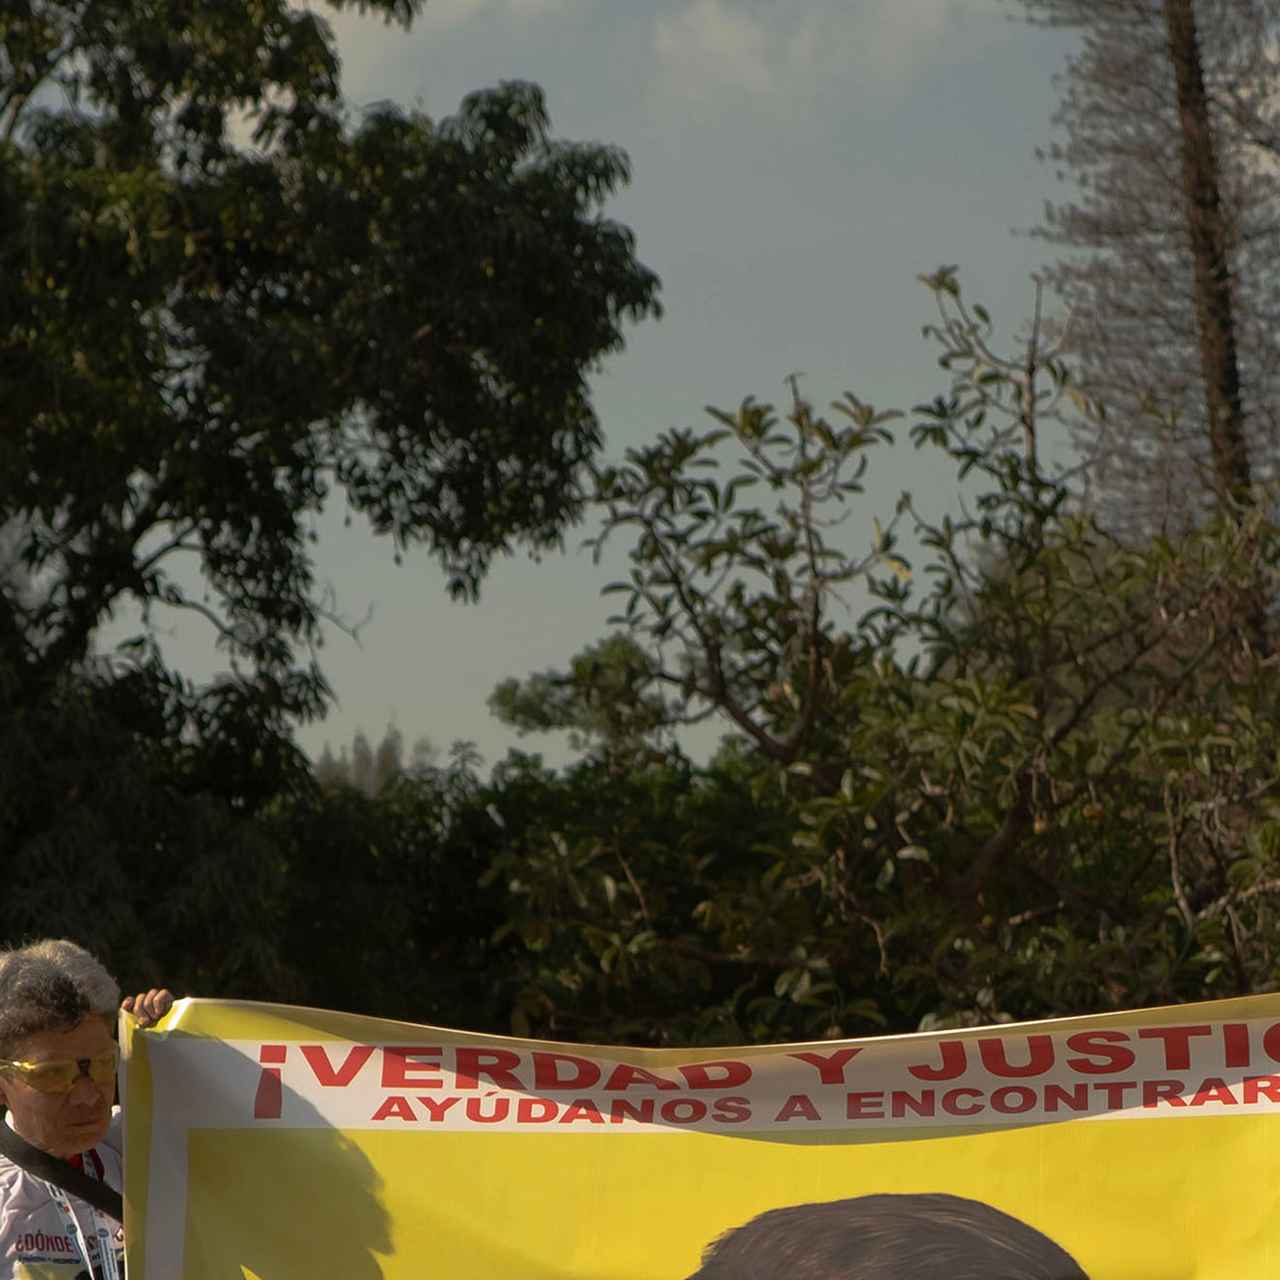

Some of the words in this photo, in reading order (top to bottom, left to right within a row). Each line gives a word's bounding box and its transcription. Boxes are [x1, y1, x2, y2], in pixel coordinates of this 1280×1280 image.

[254, 1045, 752, 1119] ¡VERDAD
[784, 1047, 862, 1086] Y
[371, 1092, 751, 1124] AYÚDANOS
[774, 1094, 821, 1122] A
